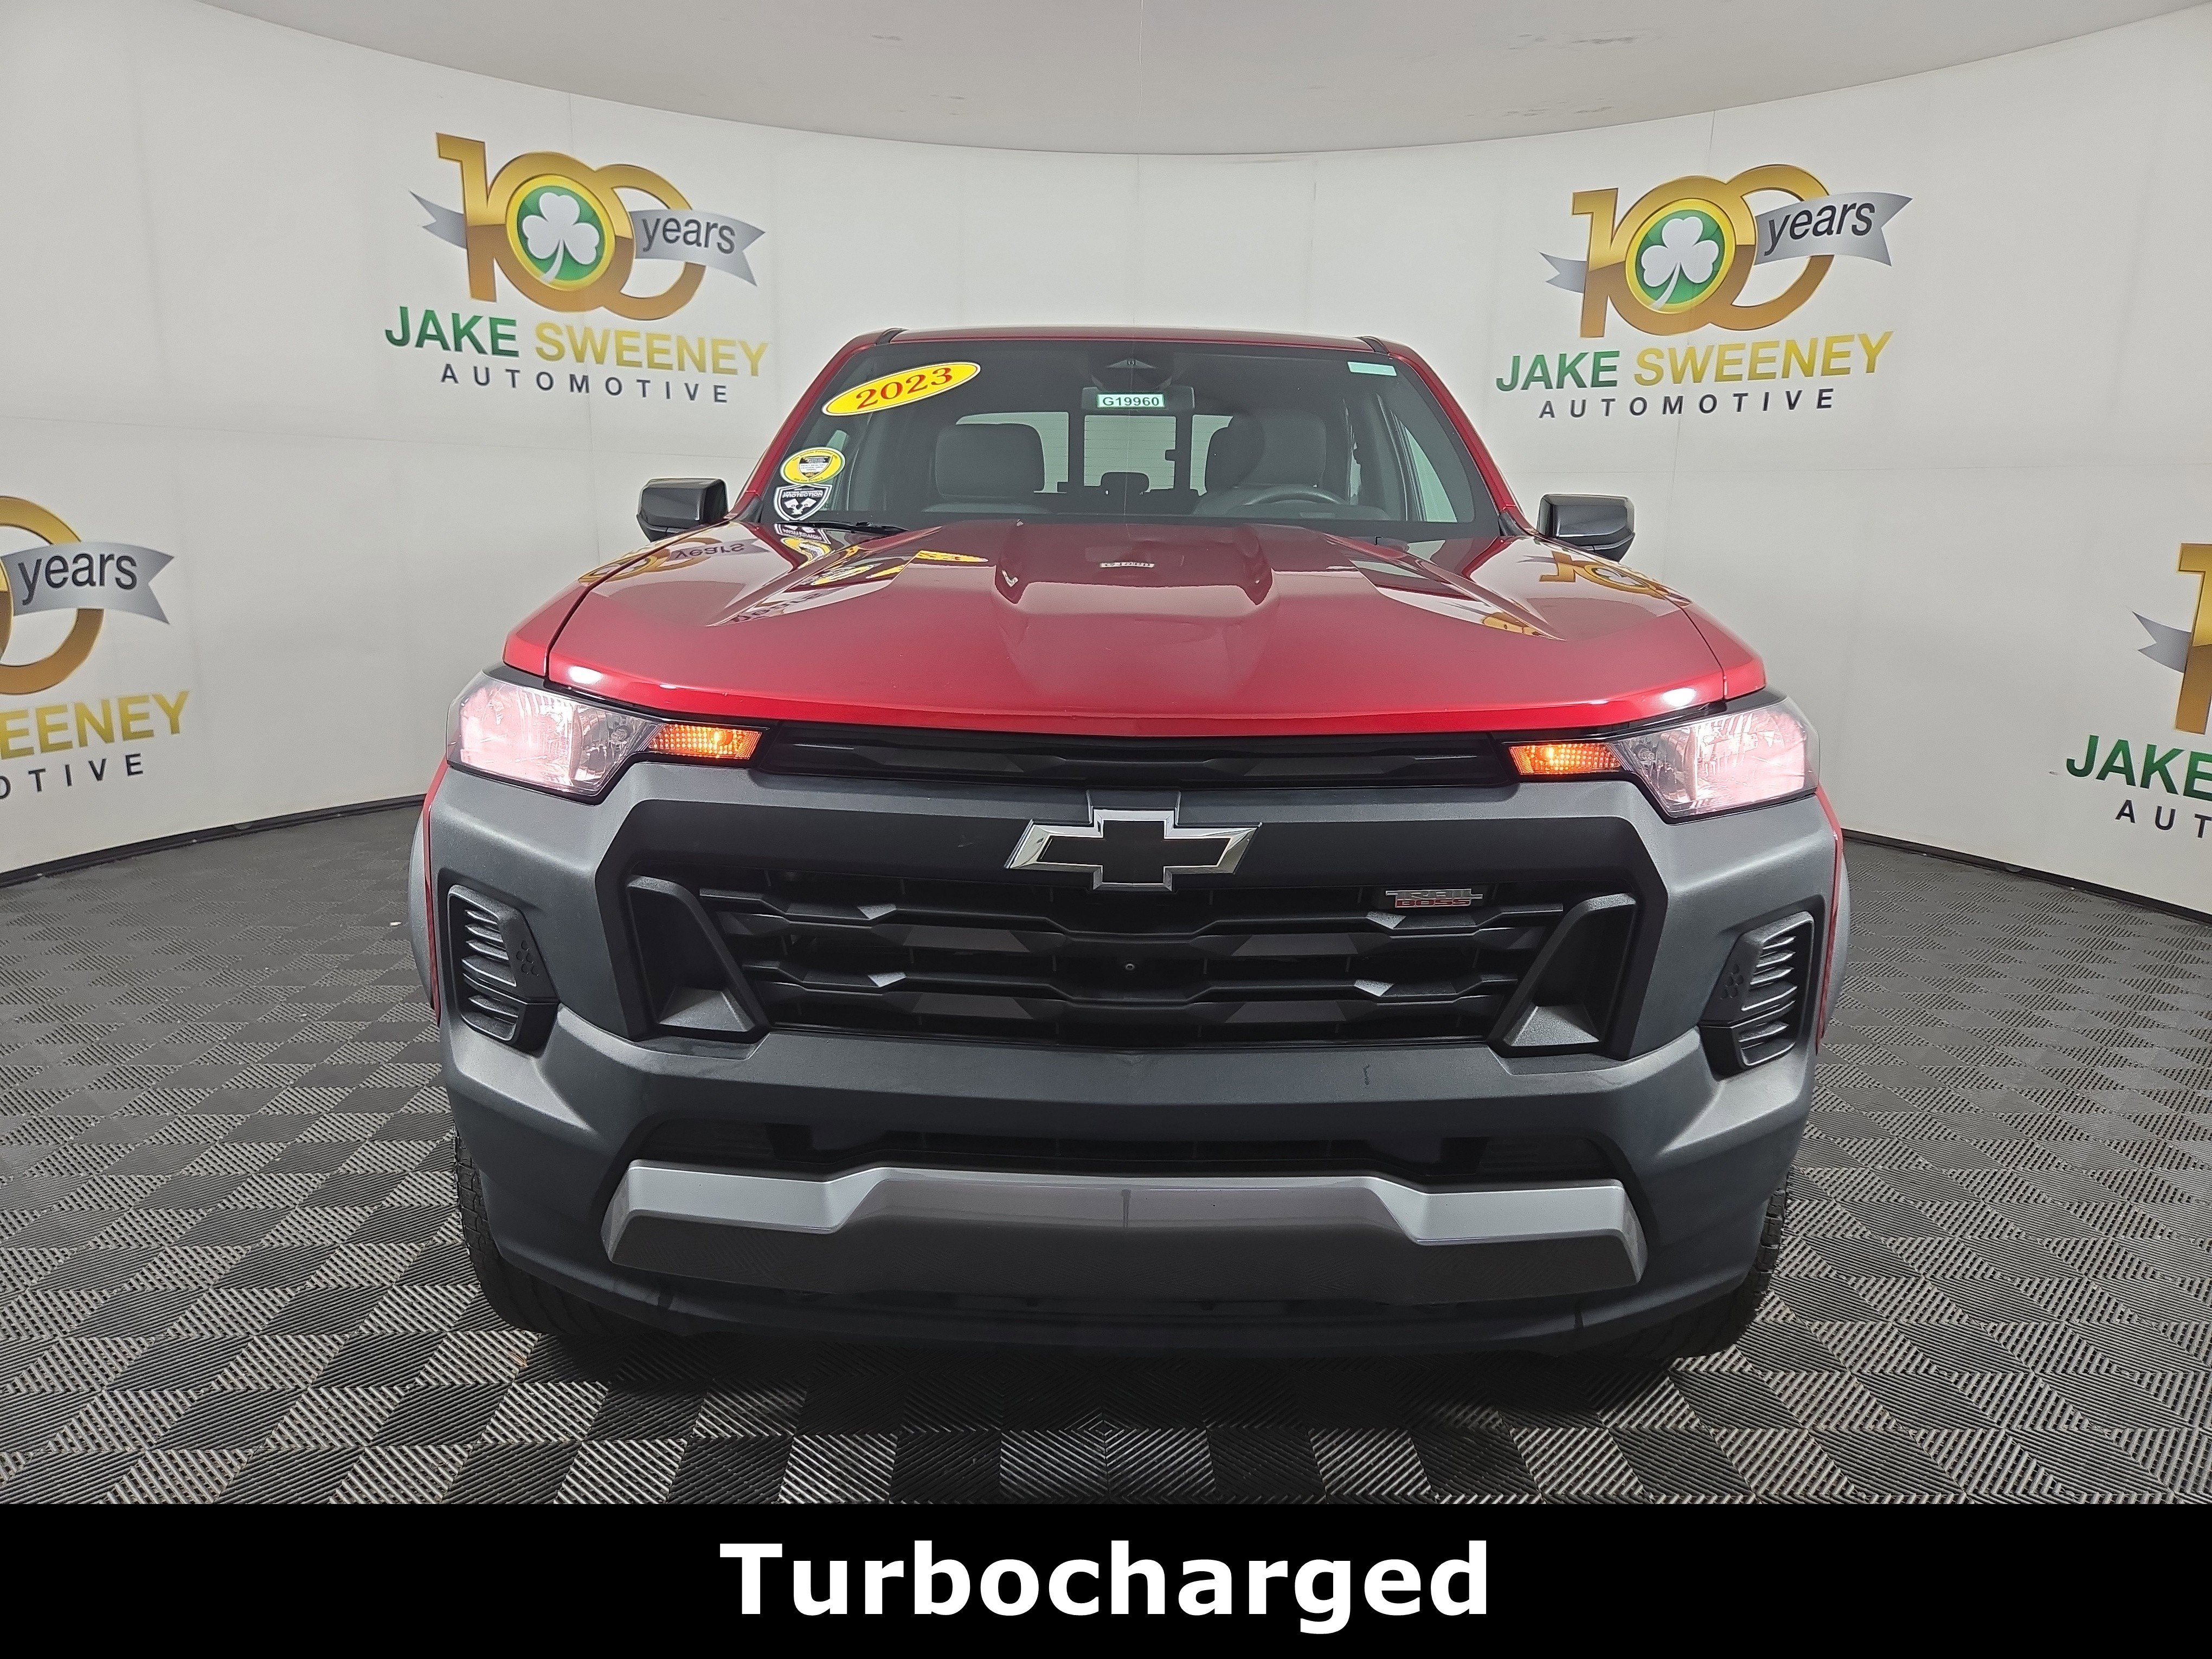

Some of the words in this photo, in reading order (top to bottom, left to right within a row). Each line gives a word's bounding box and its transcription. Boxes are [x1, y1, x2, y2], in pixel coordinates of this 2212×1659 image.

[436, 132, 705, 320] 100
[642, 216, 736, 254] years
[1572, 164, 1834, 338] 100
[1764, 198, 1875, 256] years
[385, 306, 519, 358] JAKE
[535, 320, 769, 377] SWEENEY
[1496, 350, 1620, 391] JAKE
[1634, 331, 1894, 386] SWEENEY
[441, 363, 727, 403] AUTOMOTIVE
[856, 367, 953, 409] 2023
[1102, 397, 1159, 406] G19960
[1539, 388, 1834, 419] AUTOMOTIVE
[18, 553, 137, 606] years
[2066, 734, 2212, 801] JAKE
